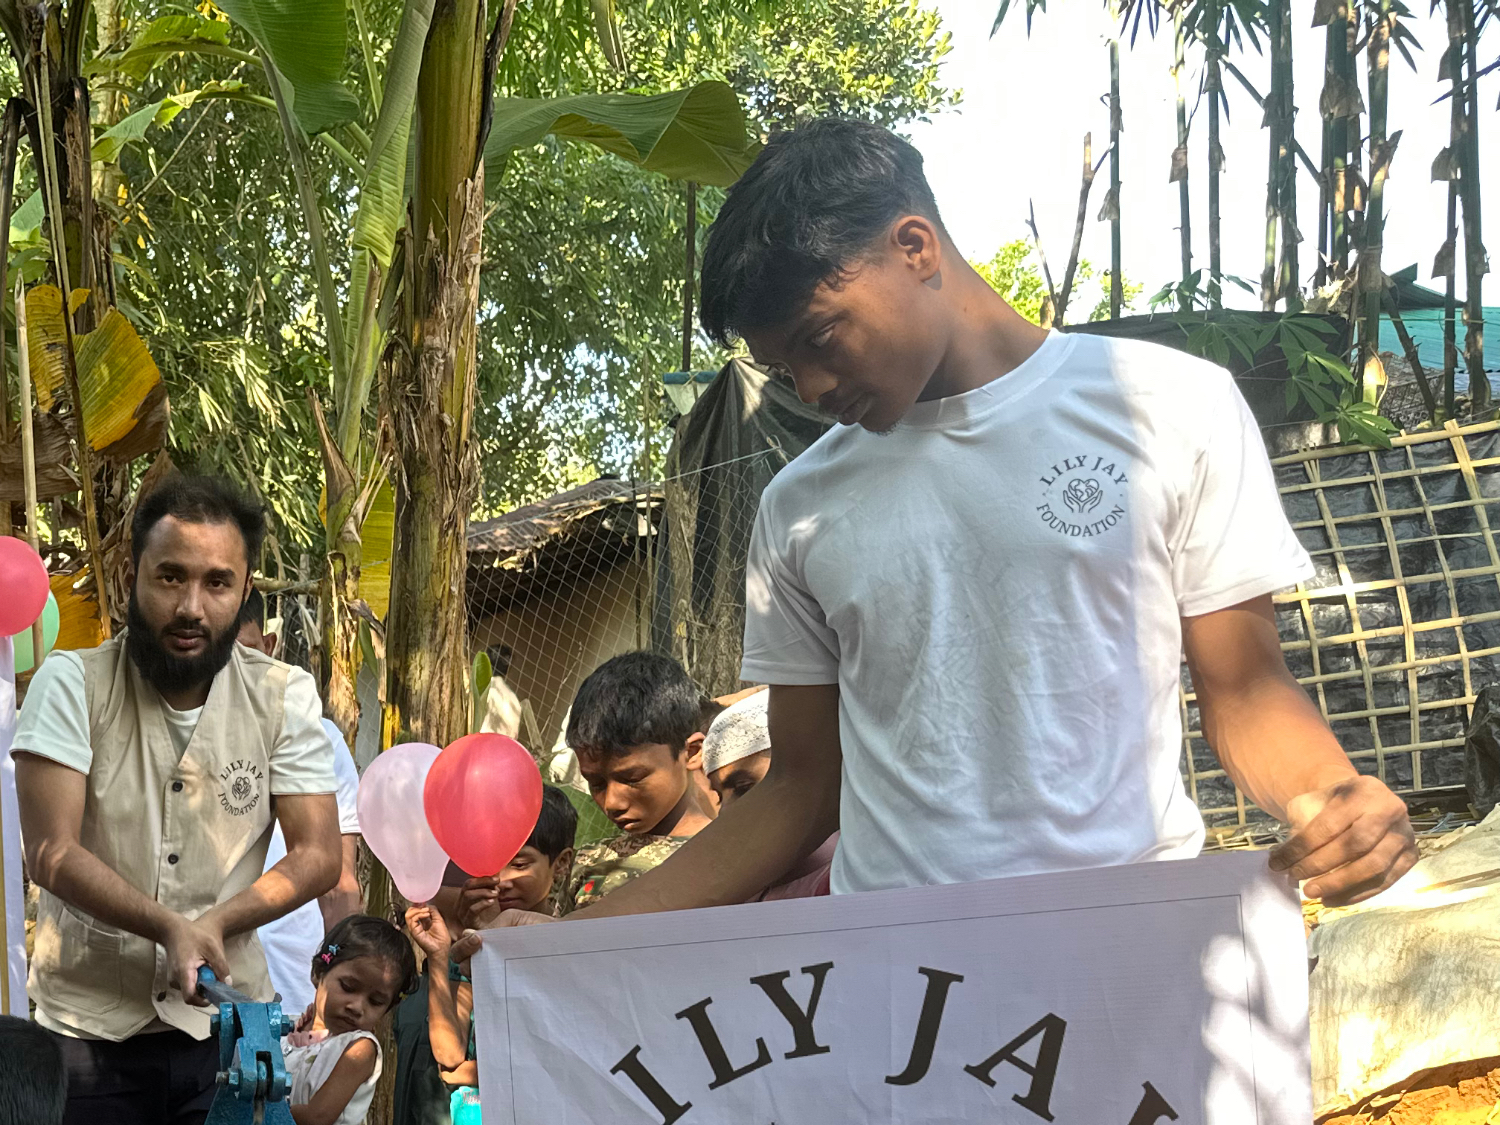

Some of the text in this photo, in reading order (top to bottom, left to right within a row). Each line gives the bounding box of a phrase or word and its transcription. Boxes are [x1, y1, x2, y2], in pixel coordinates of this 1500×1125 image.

[1039, 455, 1129, 486] LILY JAY
[1036, 503, 1126, 537] FOUNDATION
[220, 759, 264, 781] LILY JAY
[218, 792, 260, 816] FOUNDATION
